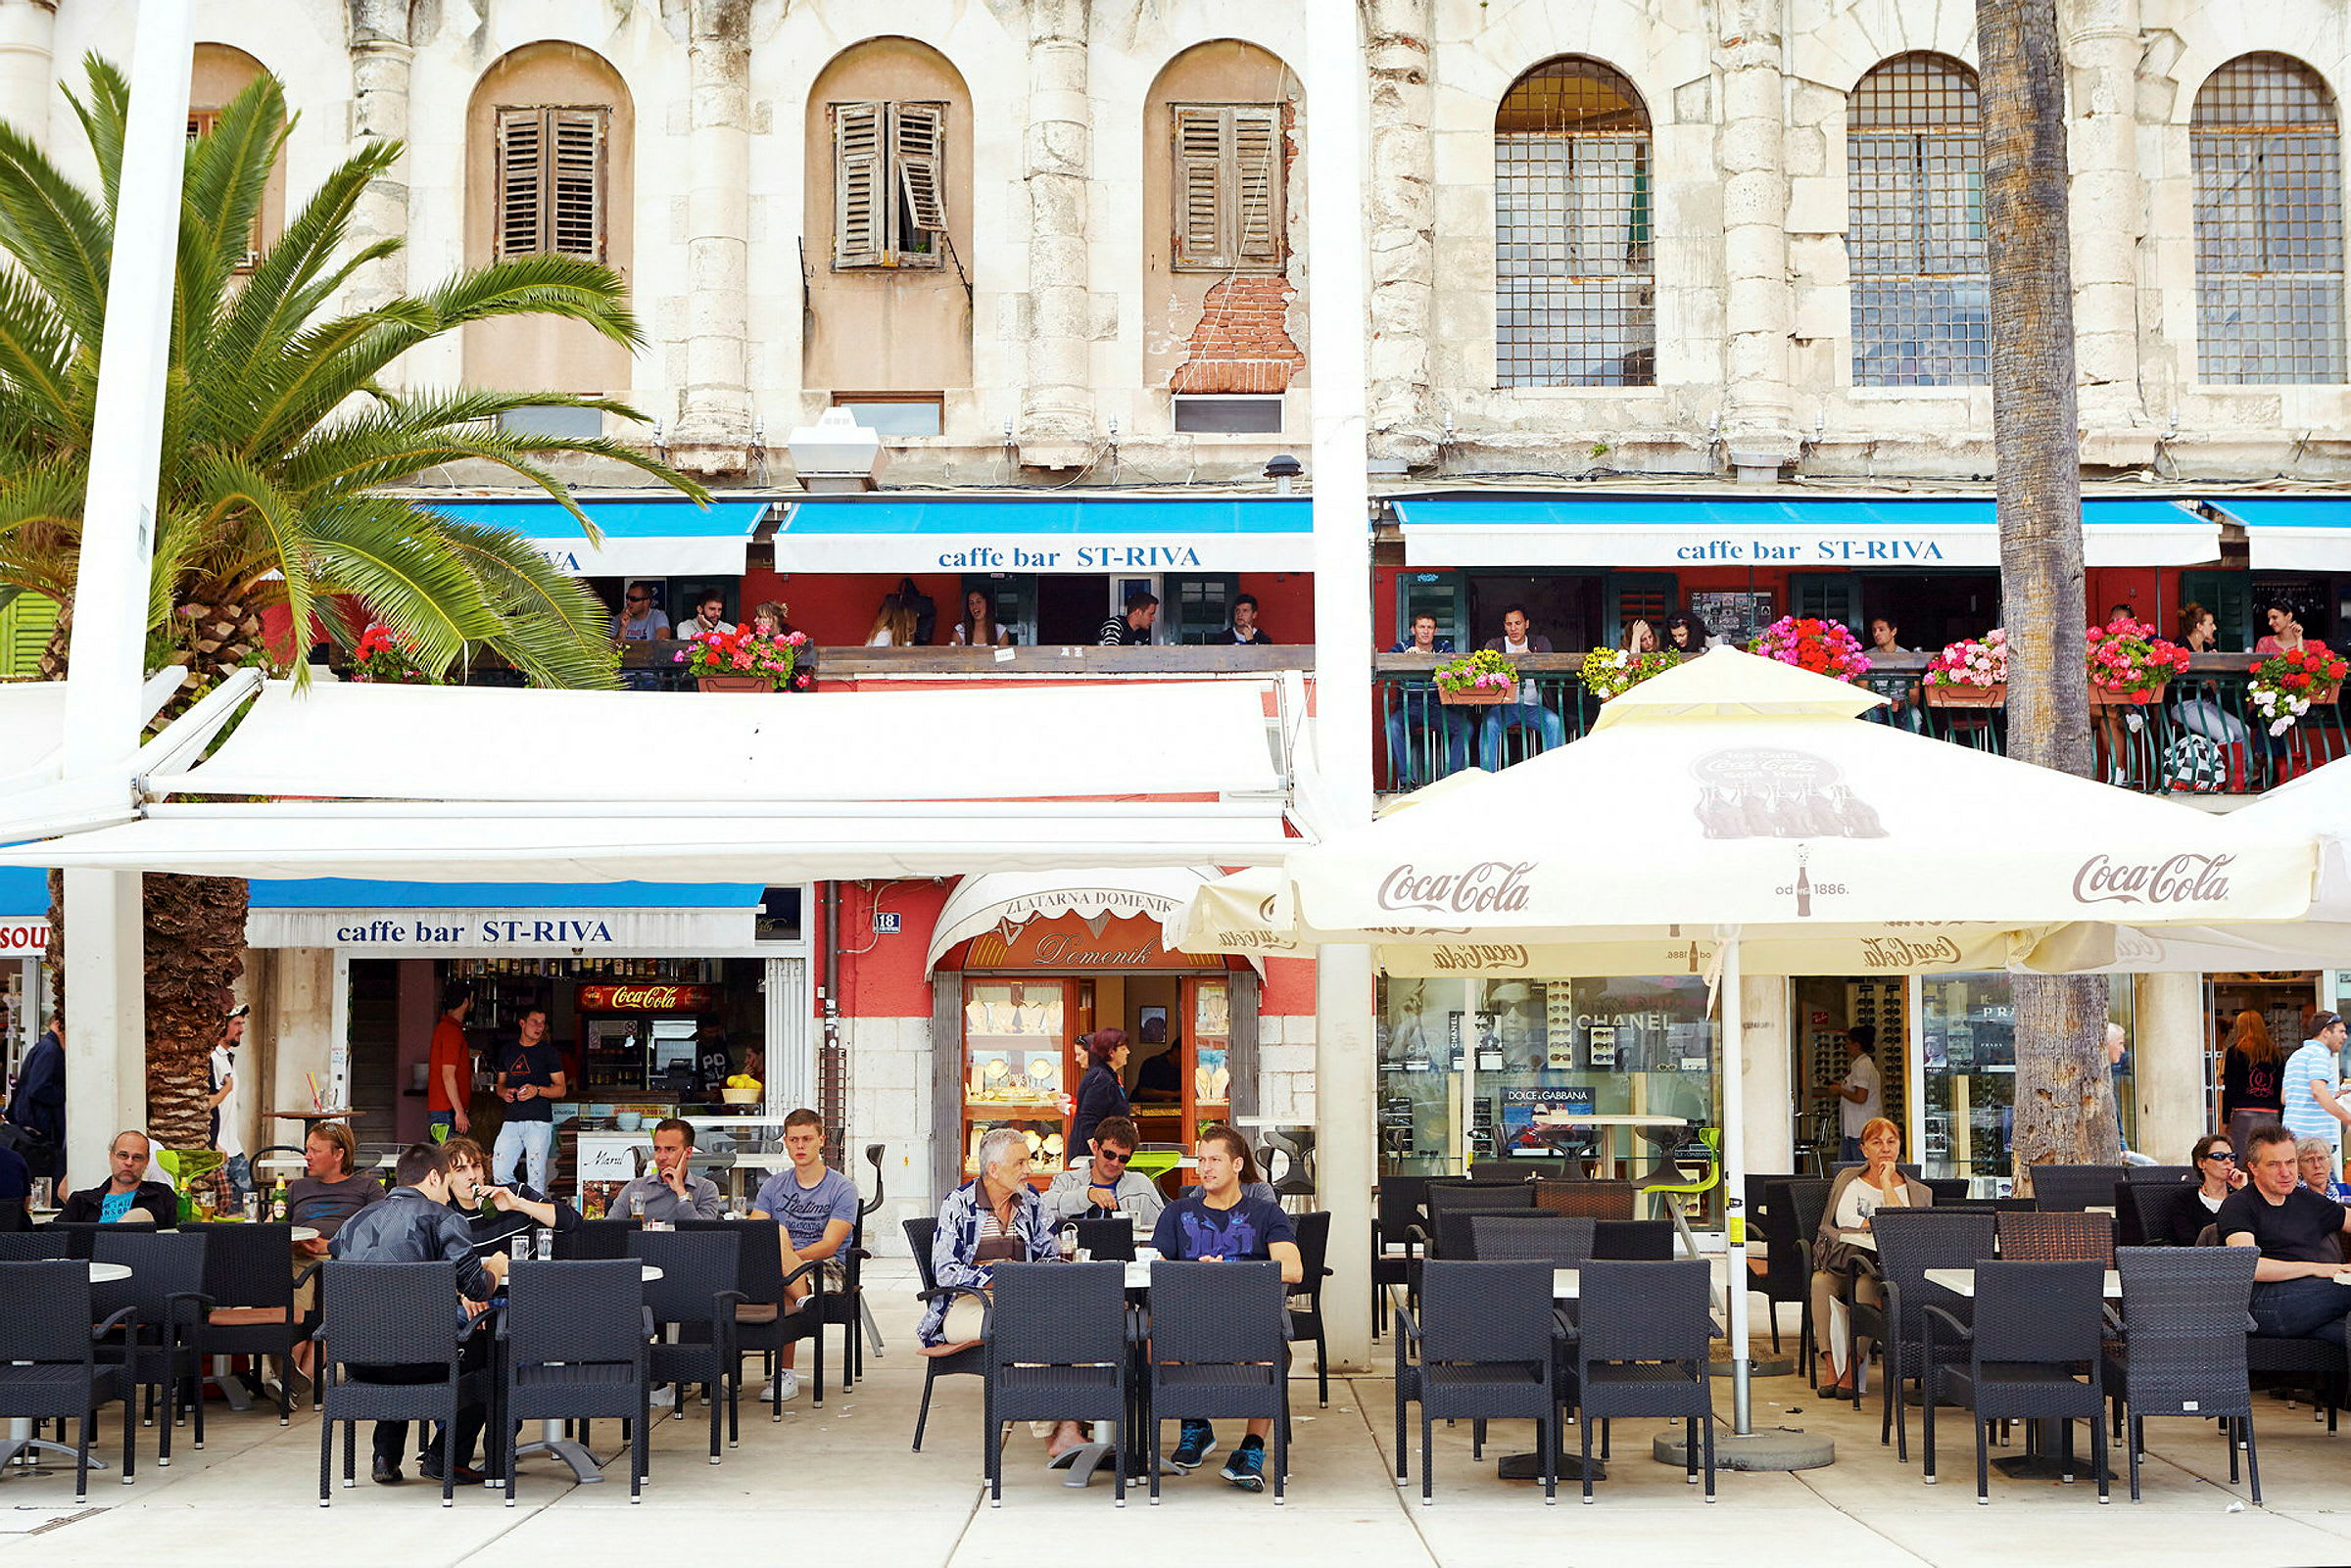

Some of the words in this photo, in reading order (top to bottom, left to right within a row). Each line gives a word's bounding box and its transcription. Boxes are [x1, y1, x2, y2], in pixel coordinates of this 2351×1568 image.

[939, 547, 1003, 567] caffe
[1015, 547, 1060, 567] bar
[1078, 546, 1201, 567] ST-RIVA
[1677, 541, 1743, 560] caffe
[1753, 541, 1800, 559] bar
[1819, 541, 1943, 559] ST-RIVA
[1378, 862, 1538, 913] Coca-Cola
[1775, 883, 1793, 895] od
[1813, 883, 1849, 895] 1886.
[2073, 853, 2236, 904] Coca-Cola
[1006, 892, 1090, 915] ZLATARNA
[1096, 892, 1175, 913] DOMENIK
[337, 921, 406, 942] caffe
[416, 920, 465, 942] bar
[483, 920, 613, 942] ST-RIVA
[879, 914, 894, 927] 18
[1033, 932, 1160, 966] Domenik
[612, 985, 680, 1009] Coca-Cola
[1576, 1014, 1675, 1031] CHANEL
